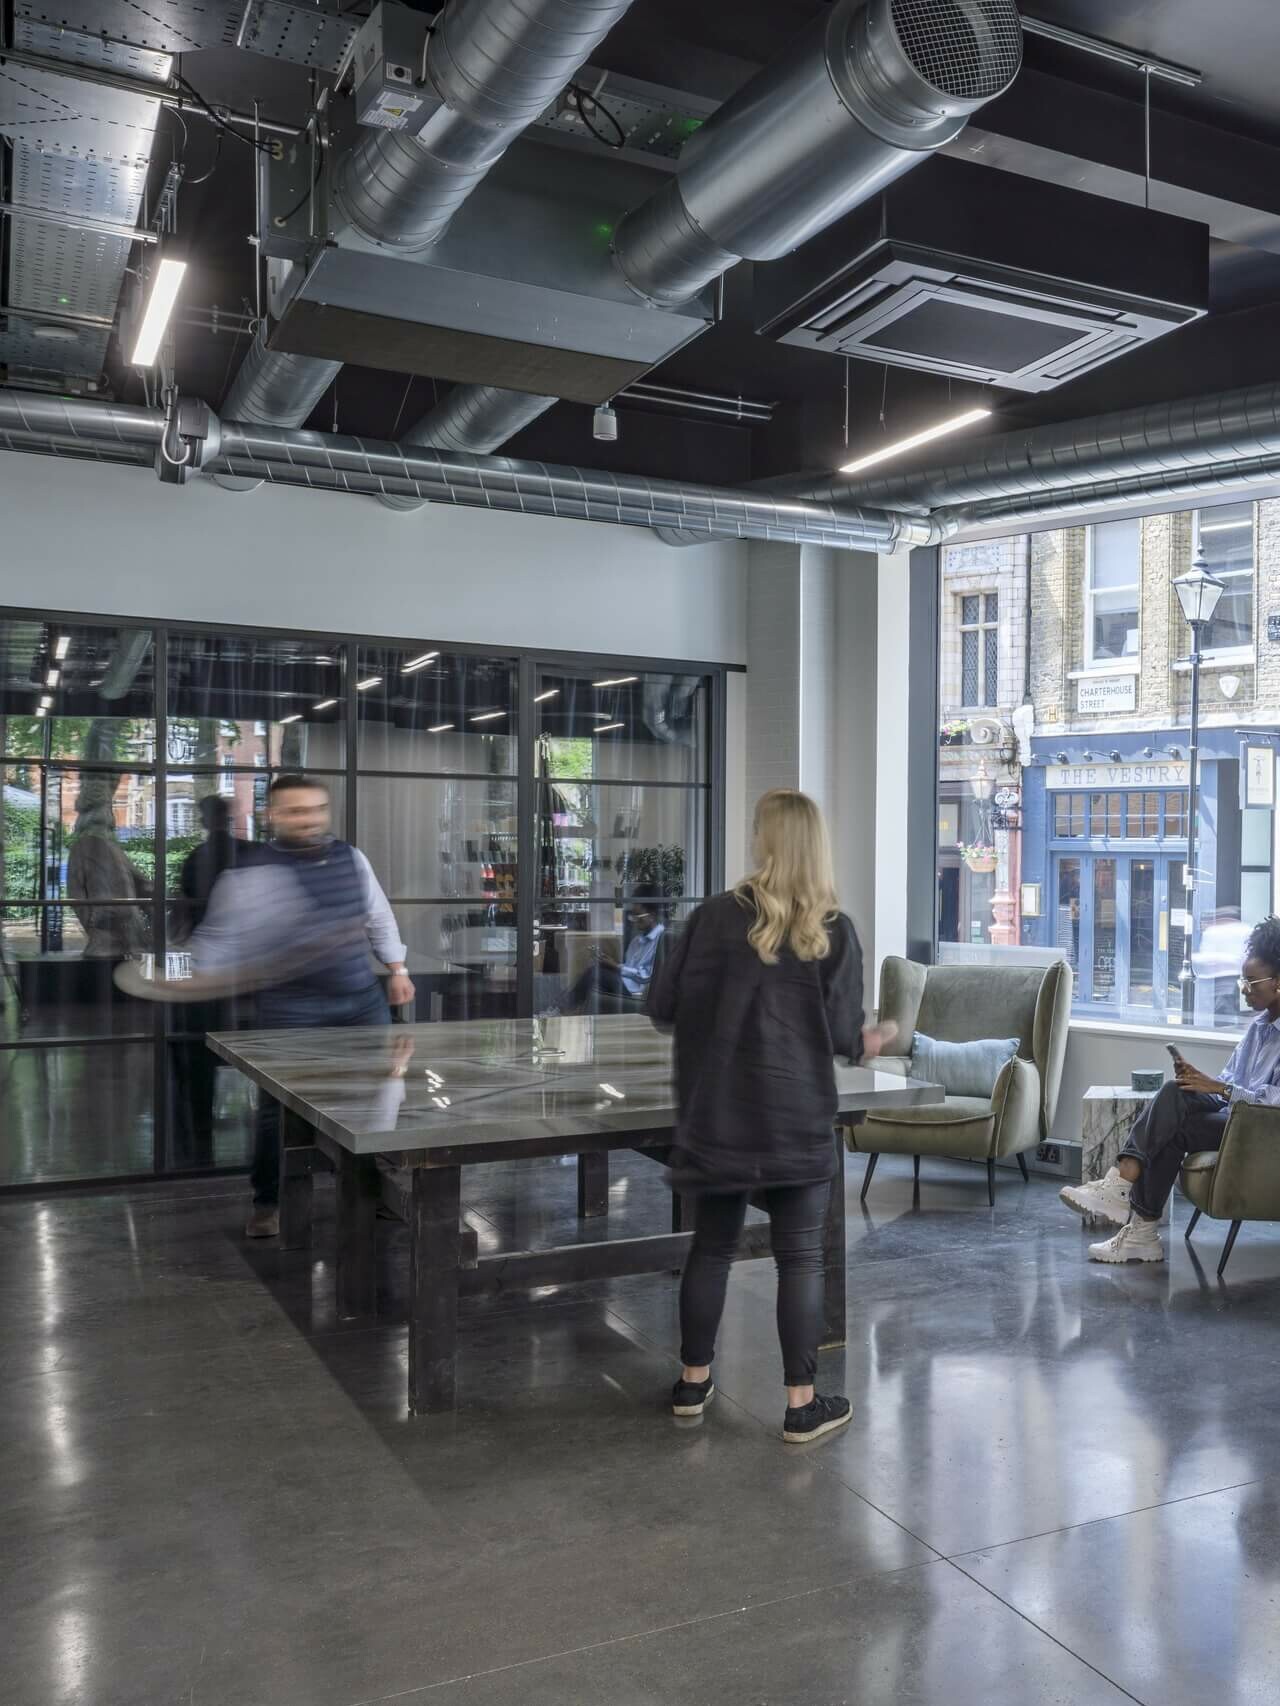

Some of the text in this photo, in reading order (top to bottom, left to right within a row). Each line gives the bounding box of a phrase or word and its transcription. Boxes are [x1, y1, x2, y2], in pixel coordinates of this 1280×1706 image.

[1080, 685, 1133, 697] CHARTERHOUSE
[1080, 699, 1105, 710] STREET
[1061, 765, 1185, 785] THE VESTRY
